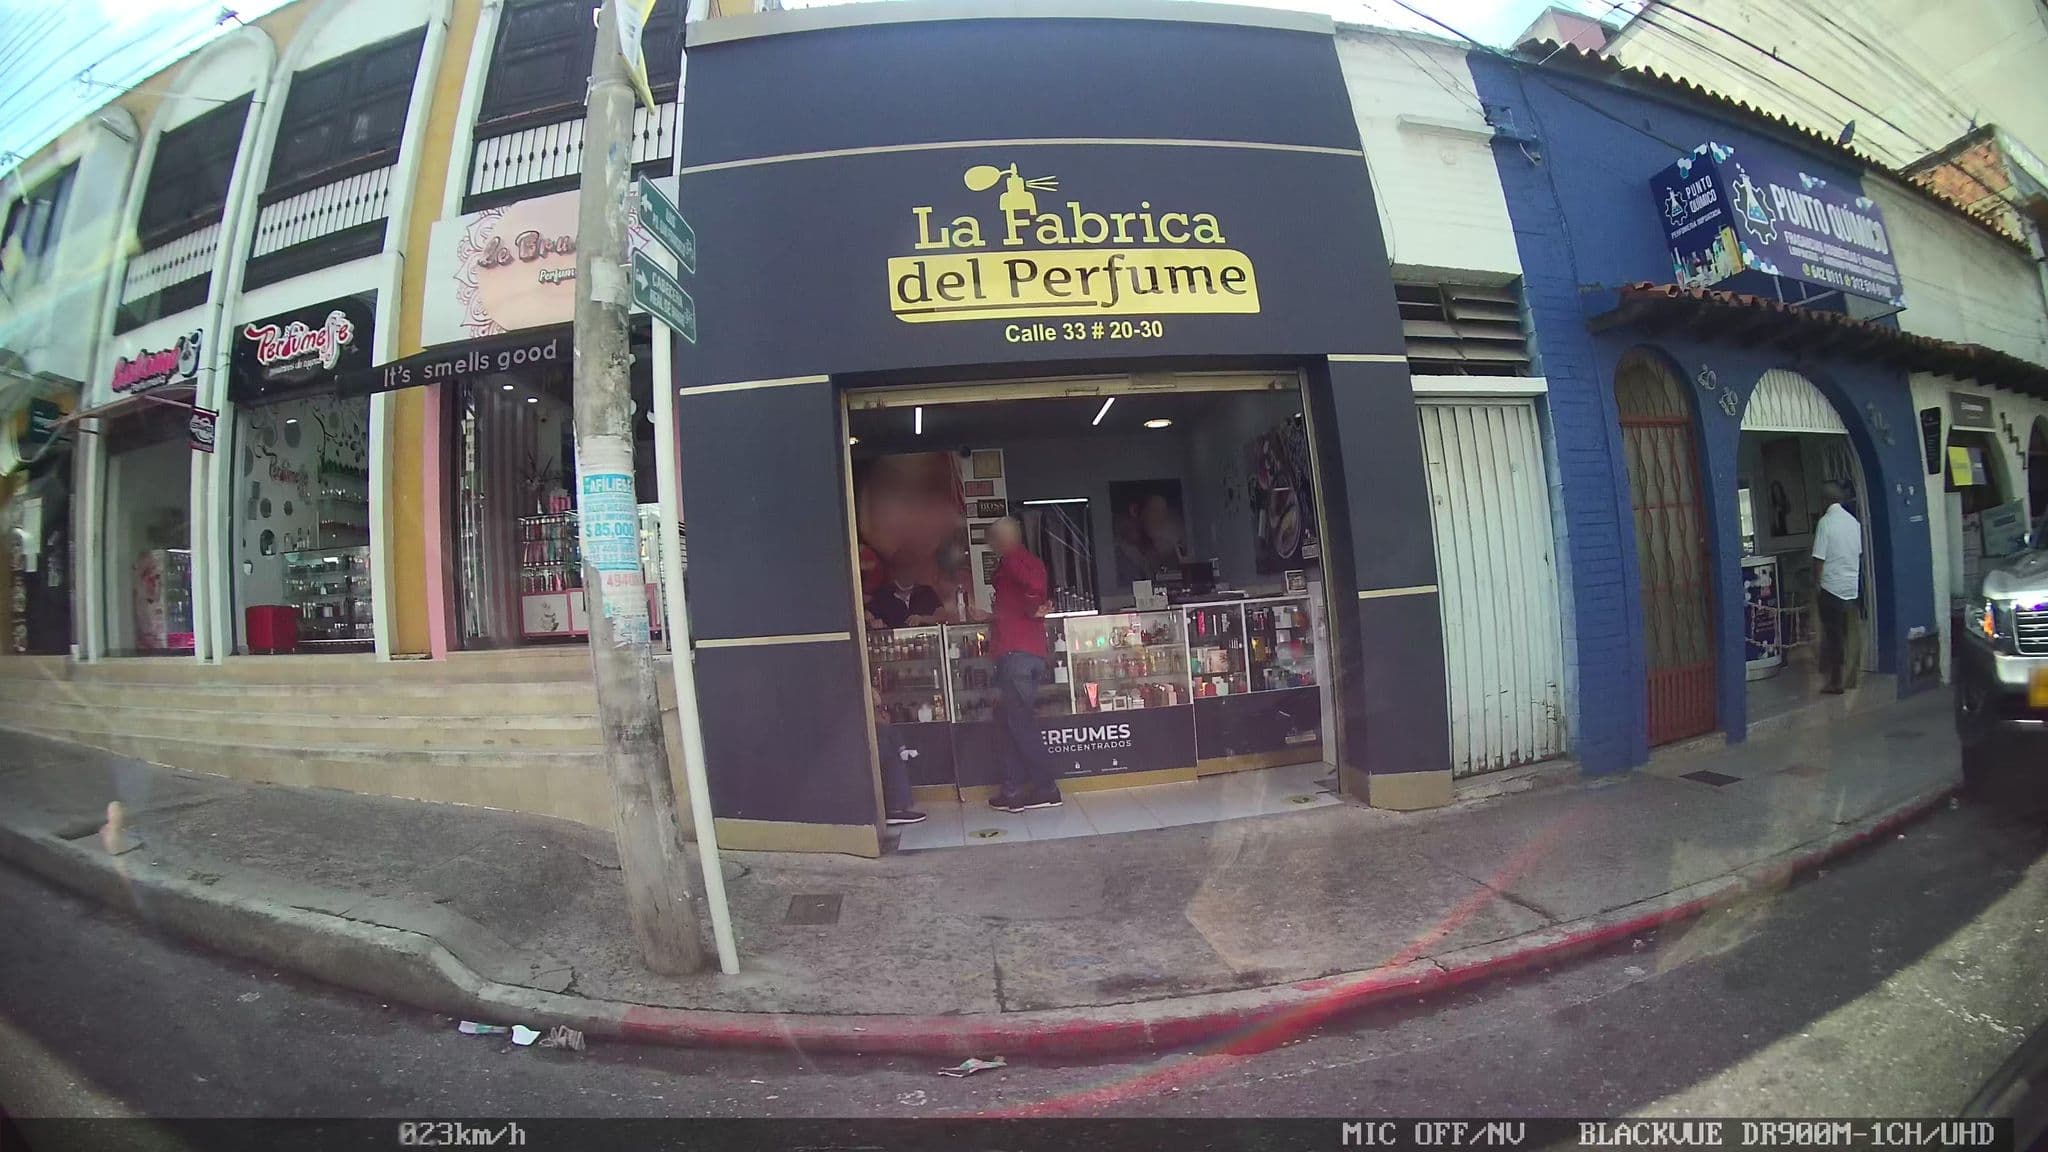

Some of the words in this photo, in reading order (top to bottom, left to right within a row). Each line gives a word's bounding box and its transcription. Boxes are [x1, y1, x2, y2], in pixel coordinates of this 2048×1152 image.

[1685, 175, 1713, 200] PUNTO
[912, 206, 986, 249] La
[1002, 201, 1226, 247] Fabrica
[1769, 183, 1830, 236] PUNTO
[897, 257, 987, 303] del
[1003, 253, 1248, 308] Perfume
[1005, 322, 1057, 343] Calle
[1063, 321, 1086, 341] 33
[1091, 321, 1104, 340] #
[1109, 320, 1164, 340] 20-30
[424, 351, 490, 380] smells
[497, 339, 558, 371] good
[585, 523, 592, 538] $
[594, 522, 635, 538] 85.000
[1047, 740, 1132, 754] CONCENTRADOS
